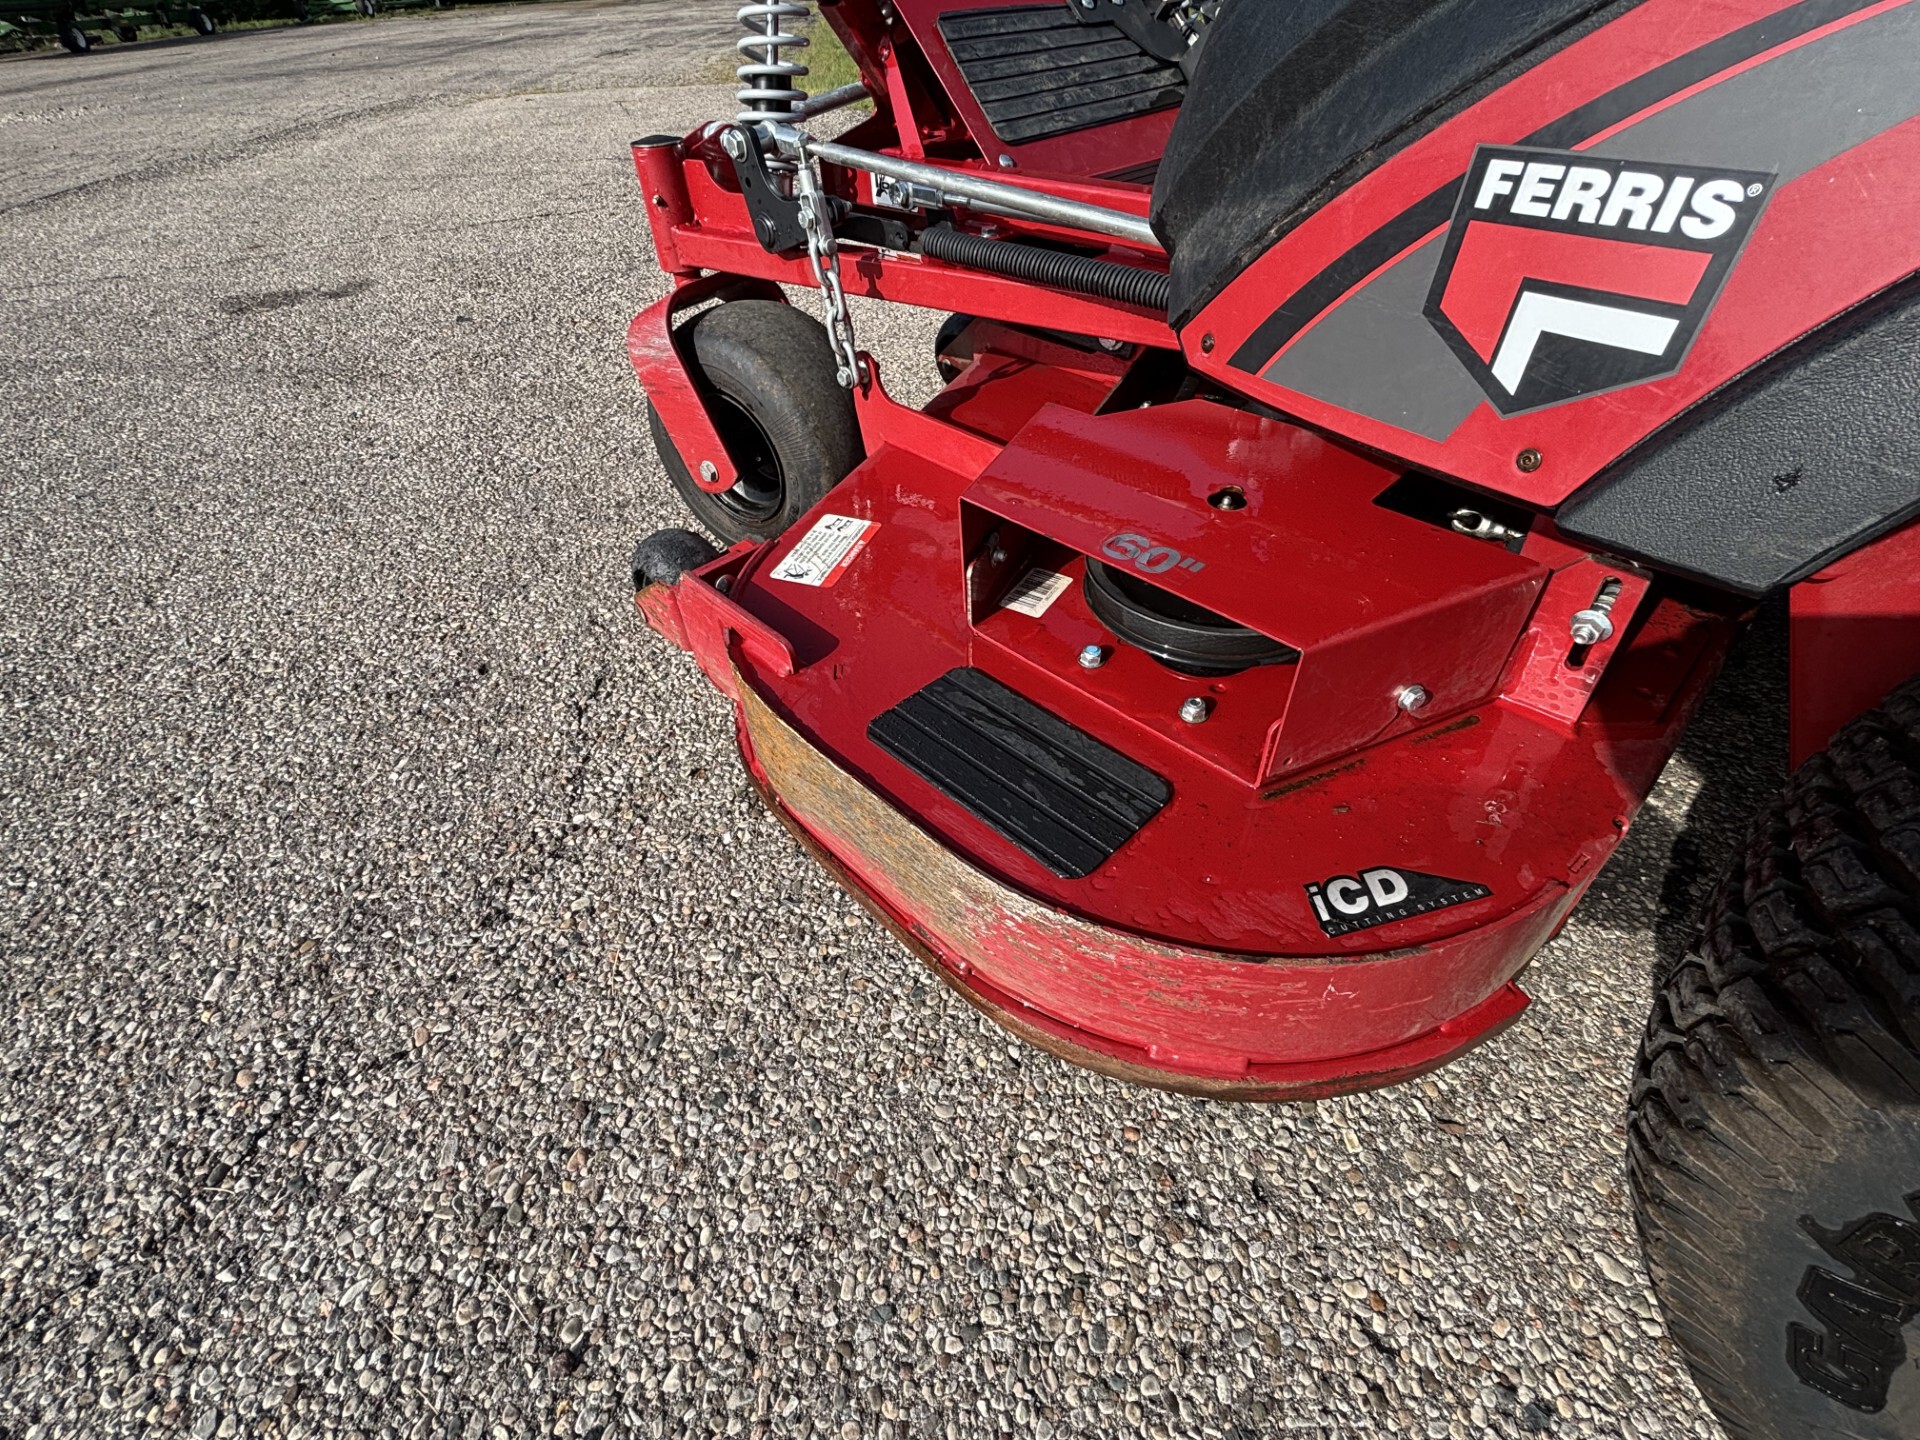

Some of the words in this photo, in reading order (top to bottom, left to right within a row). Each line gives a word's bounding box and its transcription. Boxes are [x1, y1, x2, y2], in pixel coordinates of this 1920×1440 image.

[1308, 868, 1408, 921] iCD
[1328, 908, 1407, 935] CUTTING
[1417, 887, 1488, 911] SYSTEM
